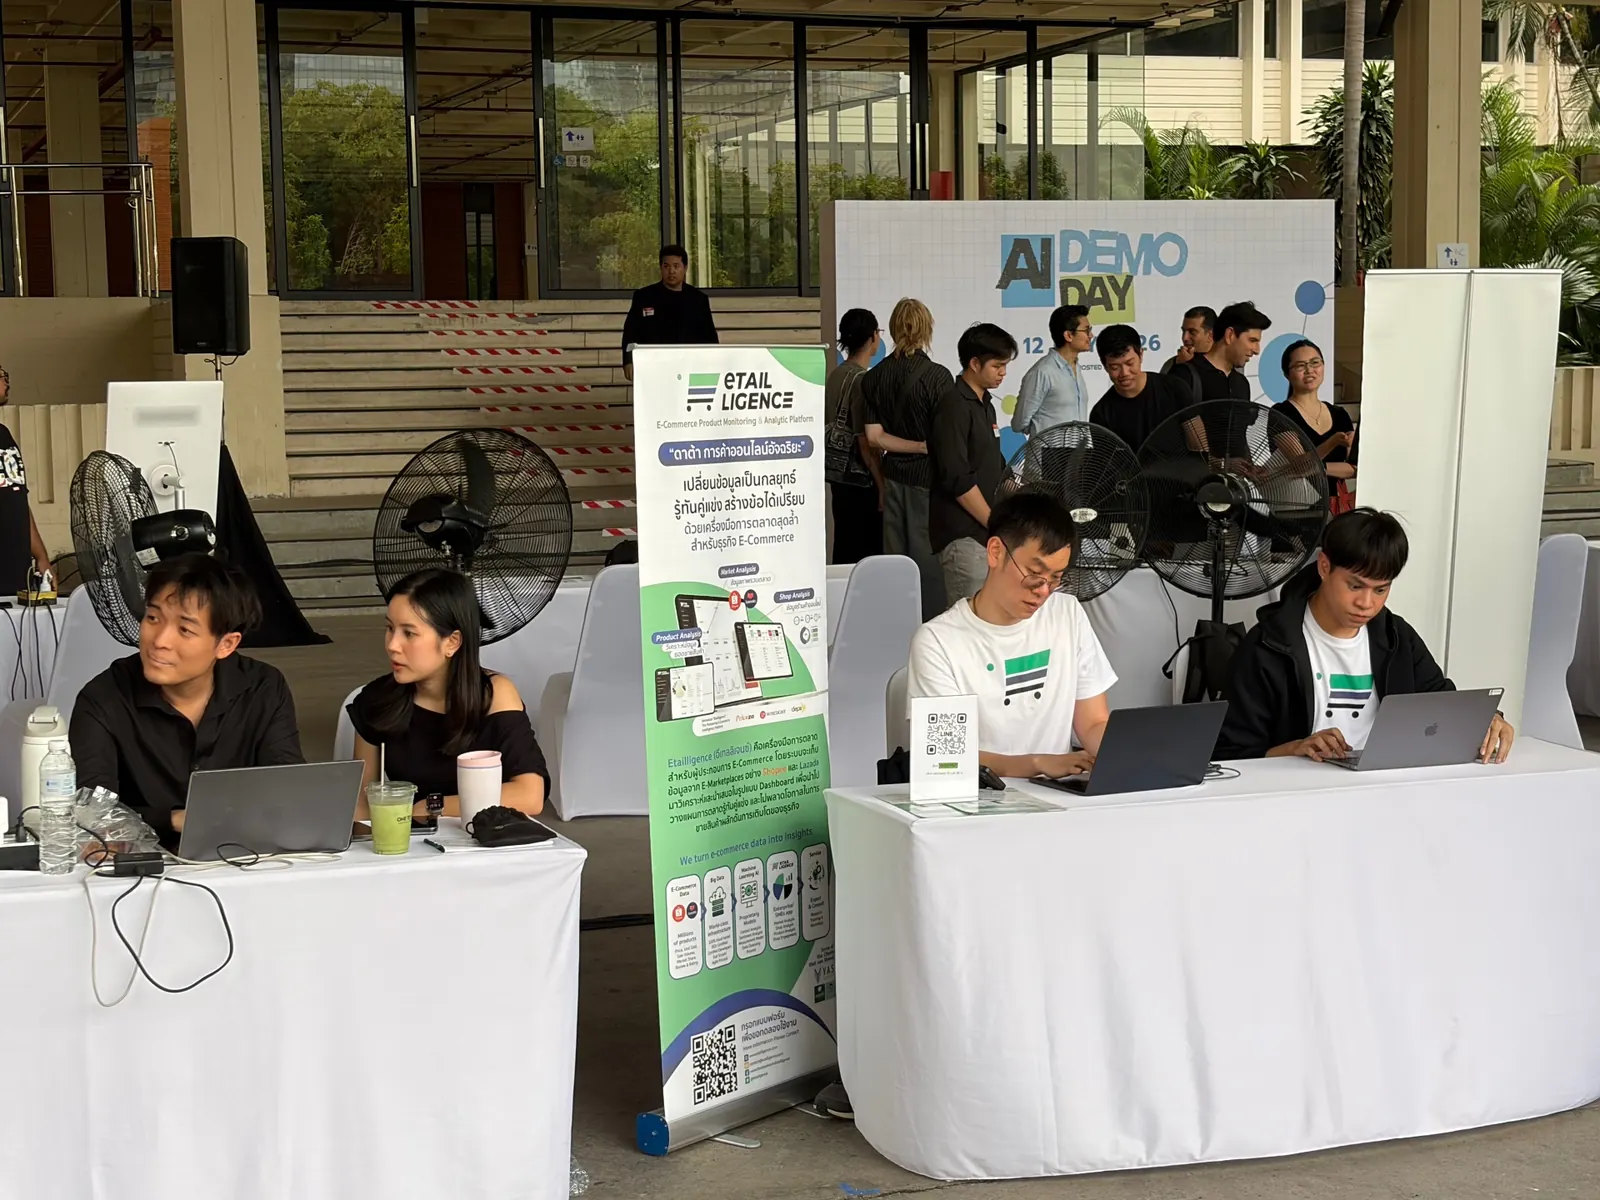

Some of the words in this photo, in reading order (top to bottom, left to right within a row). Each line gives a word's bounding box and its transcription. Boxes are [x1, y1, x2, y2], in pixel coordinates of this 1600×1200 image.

[1059, 229, 1189, 277] DEMO
[996, 238, 1052, 290] AI
[1059, 275, 1133, 312] DAY
[1023, 336, 1044, 354] 12
[721, 391, 794, 411] LIGENCE
[656, 420, 698, 429] E-Commerce
[699, 418, 722, 427] Product
[723, 417, 757, 427] Monitoring
[763, 416, 788, 426] Analytic
[789, 415, 814, 423] Platform
[683, 469, 796, 493] เปลี่ยนข้อมูลเป็นกลยุทธ์
[674, 496, 723, 520] รู้ทันคู่แข่ง
[724, 491, 805, 511] สร้างข้อได้เปรียบ
[691, 535, 737, 552] สำหรับธุรกิจ
[739, 533, 795, 546] E-Commerce
[736, 565, 756, 574] Analysis
[779, 593, 791, 601] Shop
[792, 591, 811, 599] Analysis
[656, 633, 679, 642] Product
[680, 631, 702, 639] Analysis
[668, 753, 712, 768] Etailligence
[732, 755, 773, 769] E-Commerce
[701, 773, 744, 790] E-Marketplaces
[760, 776, 795, 790] Dashboard
[679, 856, 693, 866] We
[693, 853, 709, 863] turn
[710, 842, 749, 859] e-commerce
[750, 838, 767, 848] data
[768, 834, 783, 844] into
[784, 827, 813, 840] insights
[671, 883, 697, 893] E-Commerce
